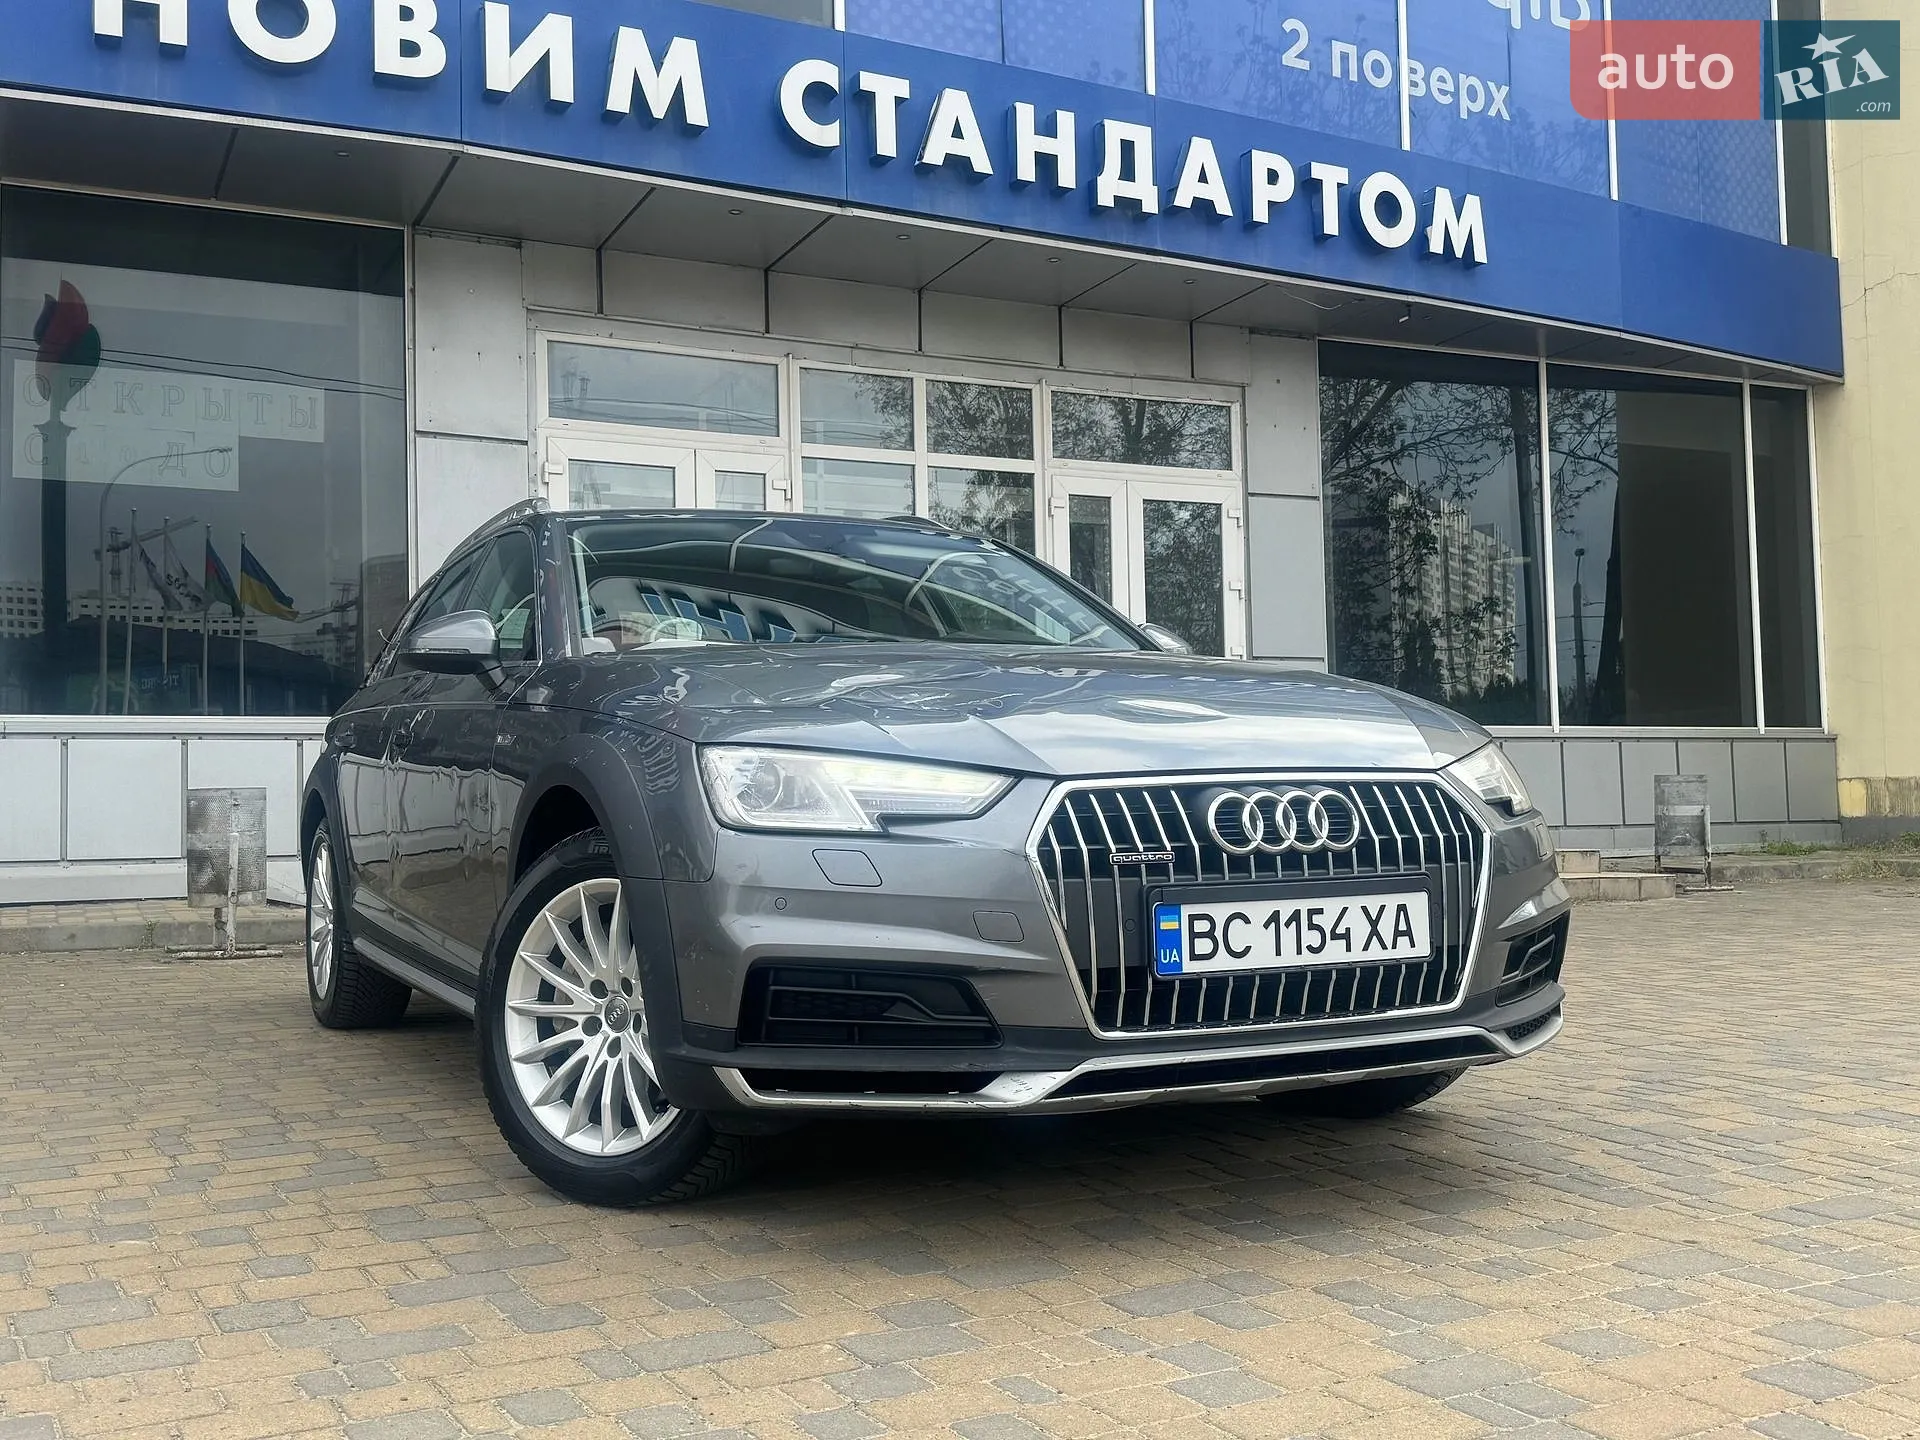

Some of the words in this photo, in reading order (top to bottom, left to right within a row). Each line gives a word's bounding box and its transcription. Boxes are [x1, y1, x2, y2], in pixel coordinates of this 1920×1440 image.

[1280, 18, 1311, 71] 2
[1331, 39, 1512, 121] поверх
[778, 59, 1488, 266] СТАНДАРТОМ
[22, 373, 319, 430] ОТКРЫТЫ
[1112, 854, 1173, 864] quattro
[1161, 948, 1180, 964] UA
[1187, 912, 1252, 962] BC
[1262, 906, 1352, 957] 1154
[1360, 903, 1416, 952] XA
